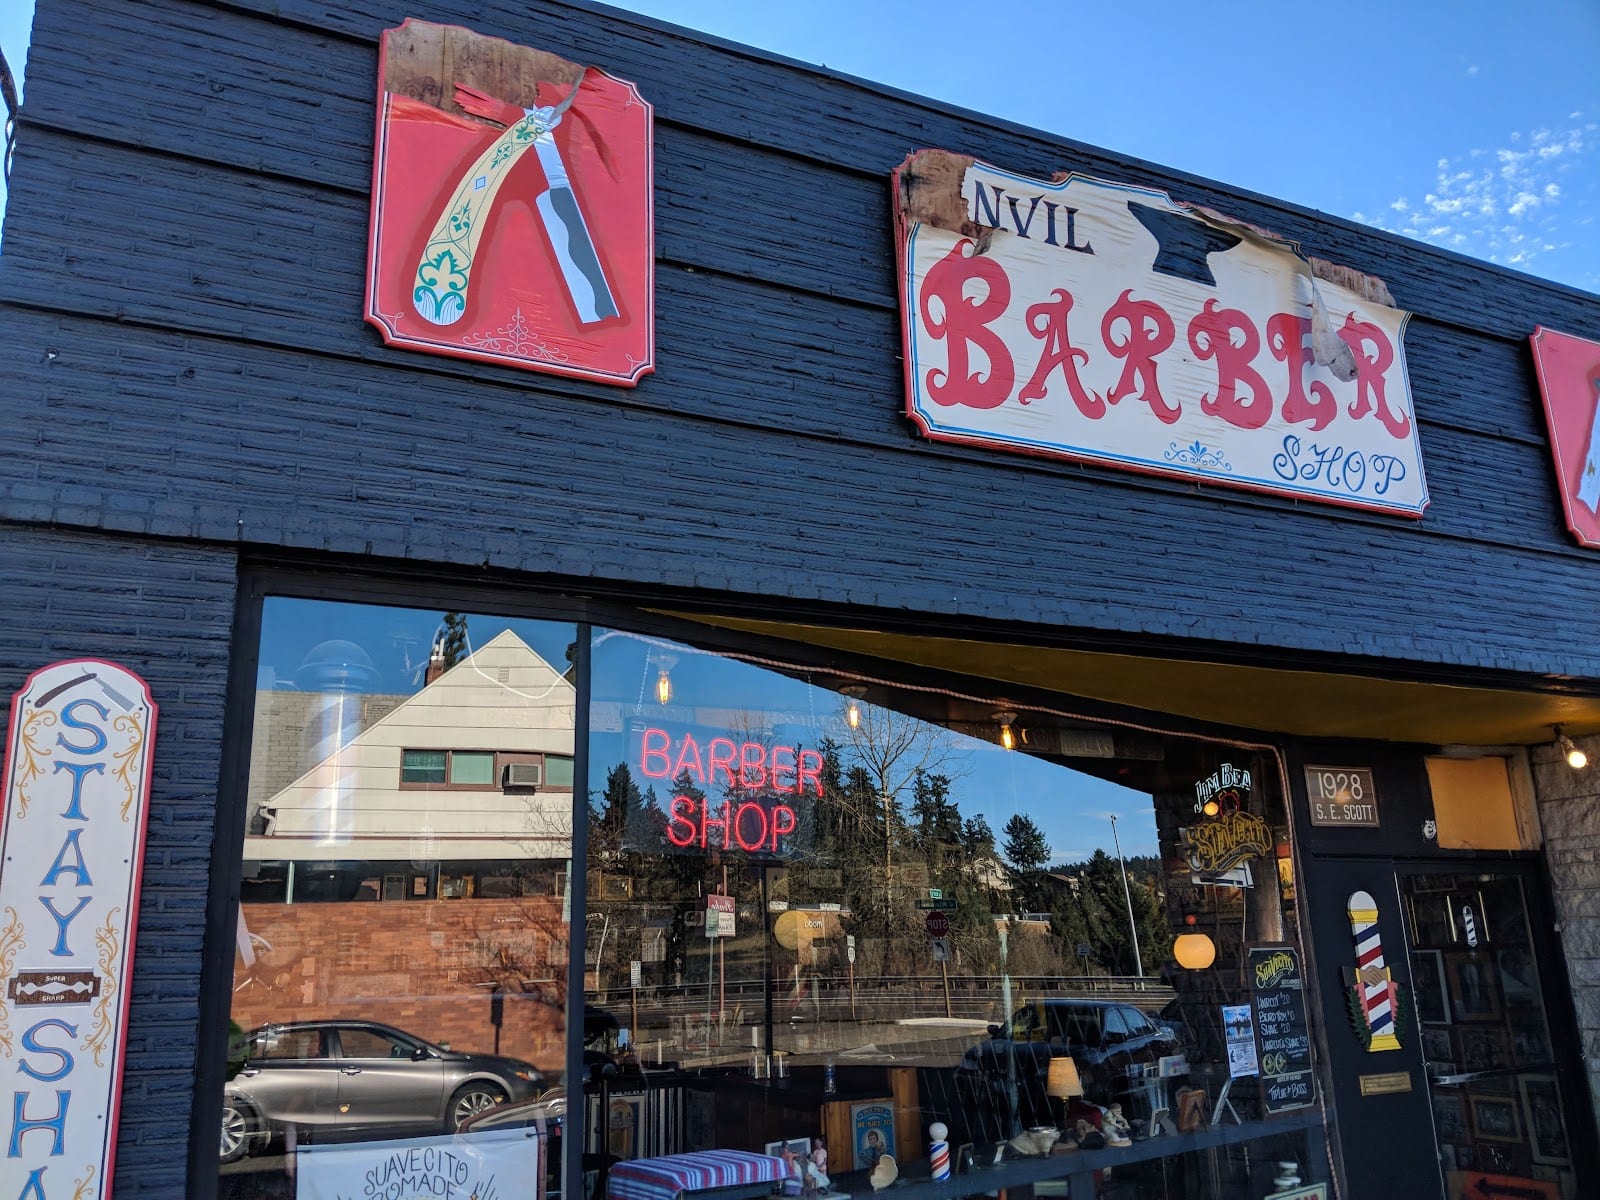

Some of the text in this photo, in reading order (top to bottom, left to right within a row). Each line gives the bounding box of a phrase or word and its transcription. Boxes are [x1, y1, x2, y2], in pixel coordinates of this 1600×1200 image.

[919, 239, 1411, 440] BARBER
[1272, 434, 1407, 495] SHOP
[640, 727, 826, 798] BARBER
[1317, 772, 1363, 800] 1928
[1193, 771, 1221, 814] JIM
[1343, 804, 1372, 821] SCOTT
[38, 698, 112, 957] STAY
[666, 795, 797, 852] SHOP
[364, 1147, 469, 1196] SUAVECITO
